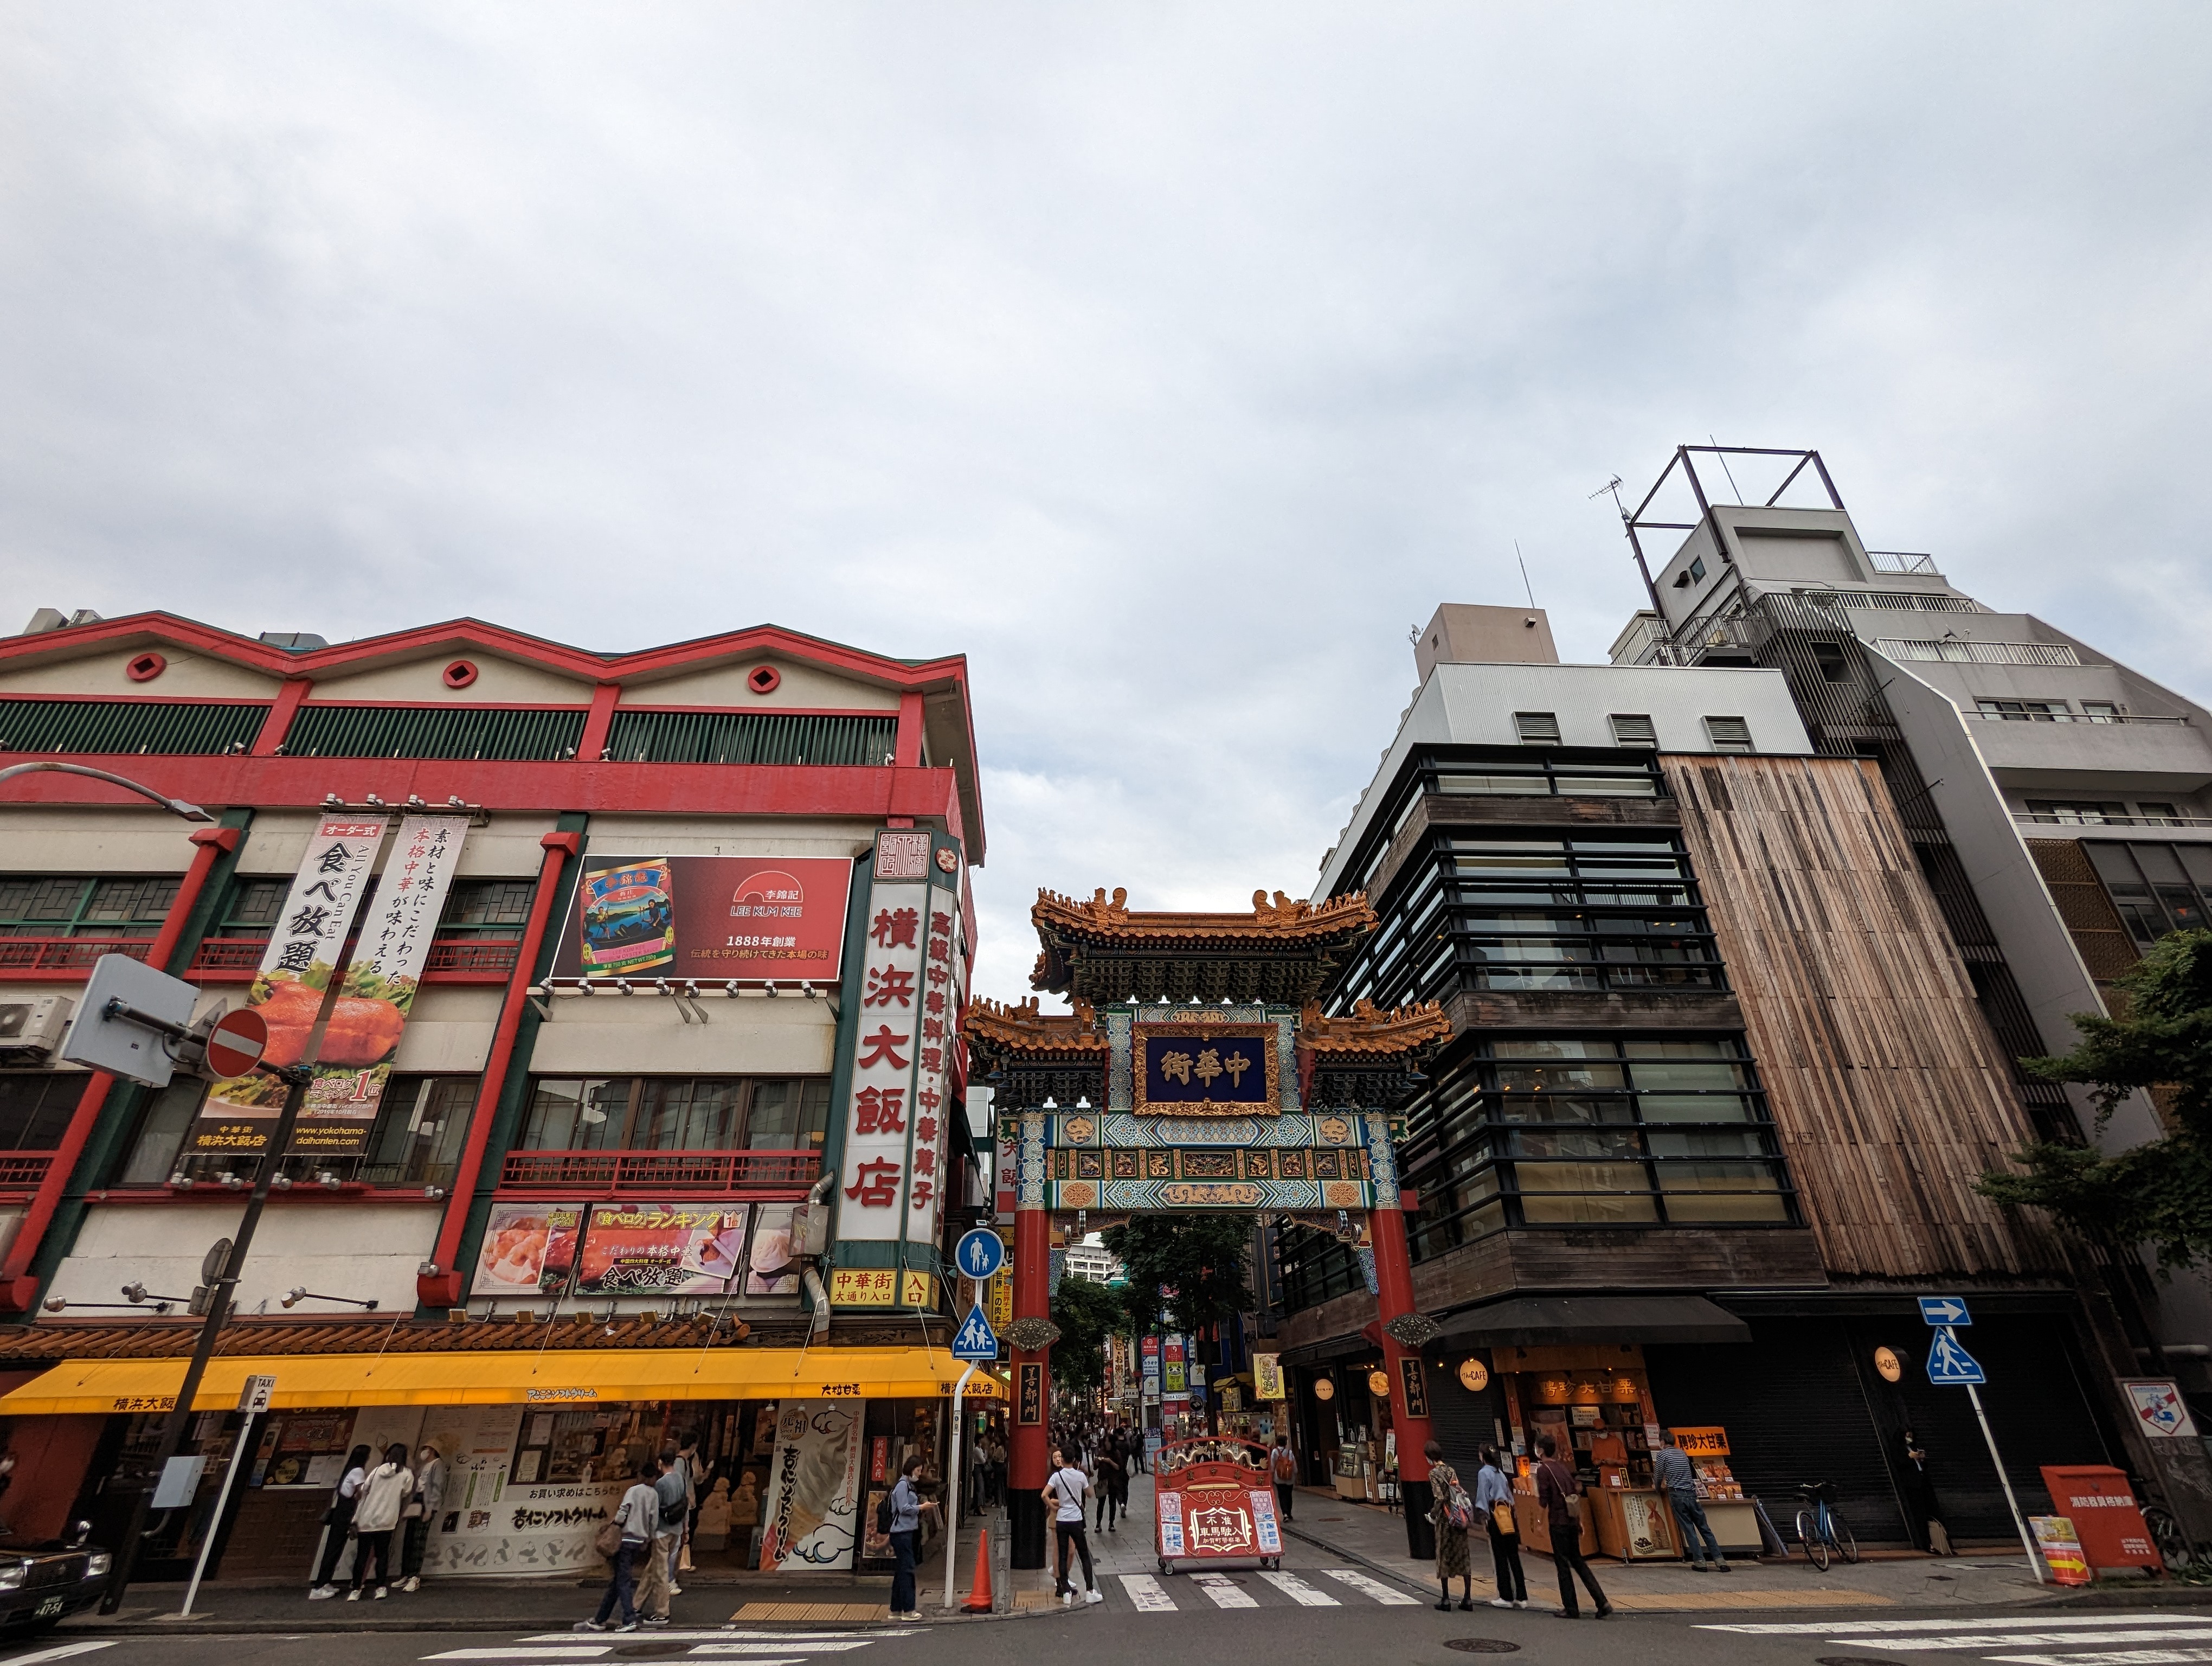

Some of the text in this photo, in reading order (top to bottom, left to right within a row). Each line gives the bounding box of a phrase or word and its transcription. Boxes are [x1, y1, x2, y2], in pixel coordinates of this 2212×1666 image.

[326, 825, 377, 836] オーダー式
[325, 844, 370, 940] All You Can Eat
[765, 890, 799, 900] 李錦記
[370, 828, 430, 974] 本格中華が味わえる
[271, 841, 354, 974] 食べ放題
[385, 829, 451, 985] 素材と味にこだわった
[731, 906, 802, 917] LEE KUM KEE
[727, 936, 796, 947] 1888年創業
[691, 949, 829, 960] 伝統を守り続けてきた本場の味
[845, 907, 919, 1208] 横浜大飯店
[311, 1078, 357, 1089] 食べログ
[310, 1089, 352, 1099] ランキング
[220, 1125, 253, 1133] 中華街
[296, 1127, 367, 1136] www.yokohama-
[197, 1135, 268, 1146] 横浜大飯店
[297, 1137, 359, 1145] daihanten.com
[601, 1245, 692, 1257] こだわりの本格中華
[600, 1267, 683, 1288] 食べ放題
[837, 1273, 893, 1290] 中華街
[906, 1274, 925, 1303] 入口
[834, 1291, 891, 1302] 大通り入口
[994, 1271, 1003, 1334] 世界一の肉まん
[1471, 1370, 1487, 1381] CAFE
[258, 1379, 275, 1387] TAXI
[1541, 1378, 1636, 1397] 聘珍大甘栗
[821, 1383, 861, 1396] 大粒甘栗
[113, 1396, 177, 1411] 横浜大飯
[781, 1412, 808, 1434] 元祖
[1677, 1433, 1727, 1450] 聘珍大甘栗
[511, 1507, 608, 1532] 杏仁ソフトクリーム
[1206, 1516, 1232, 1526] 不准
[1200, 1526, 1243, 1537] 車馬駛入
